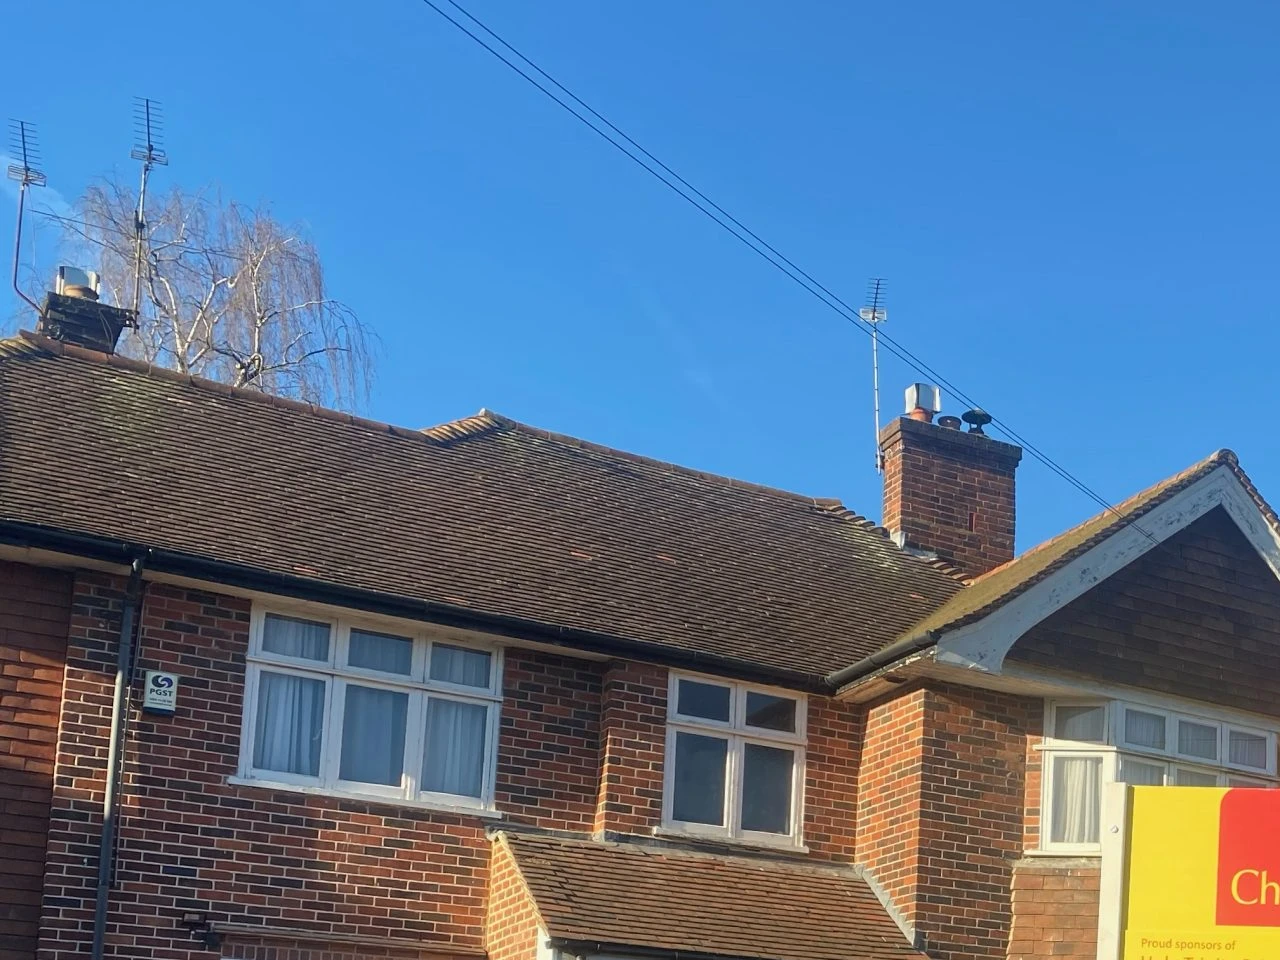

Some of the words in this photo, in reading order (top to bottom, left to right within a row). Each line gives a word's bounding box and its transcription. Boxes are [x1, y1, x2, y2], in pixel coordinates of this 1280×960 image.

[150, 688, 173, 697] PGST
[1141, 938, 1172, 949] Proud
[1175, 940, 1222, 951] sponsors
[1225, 940, 1236, 950] of
